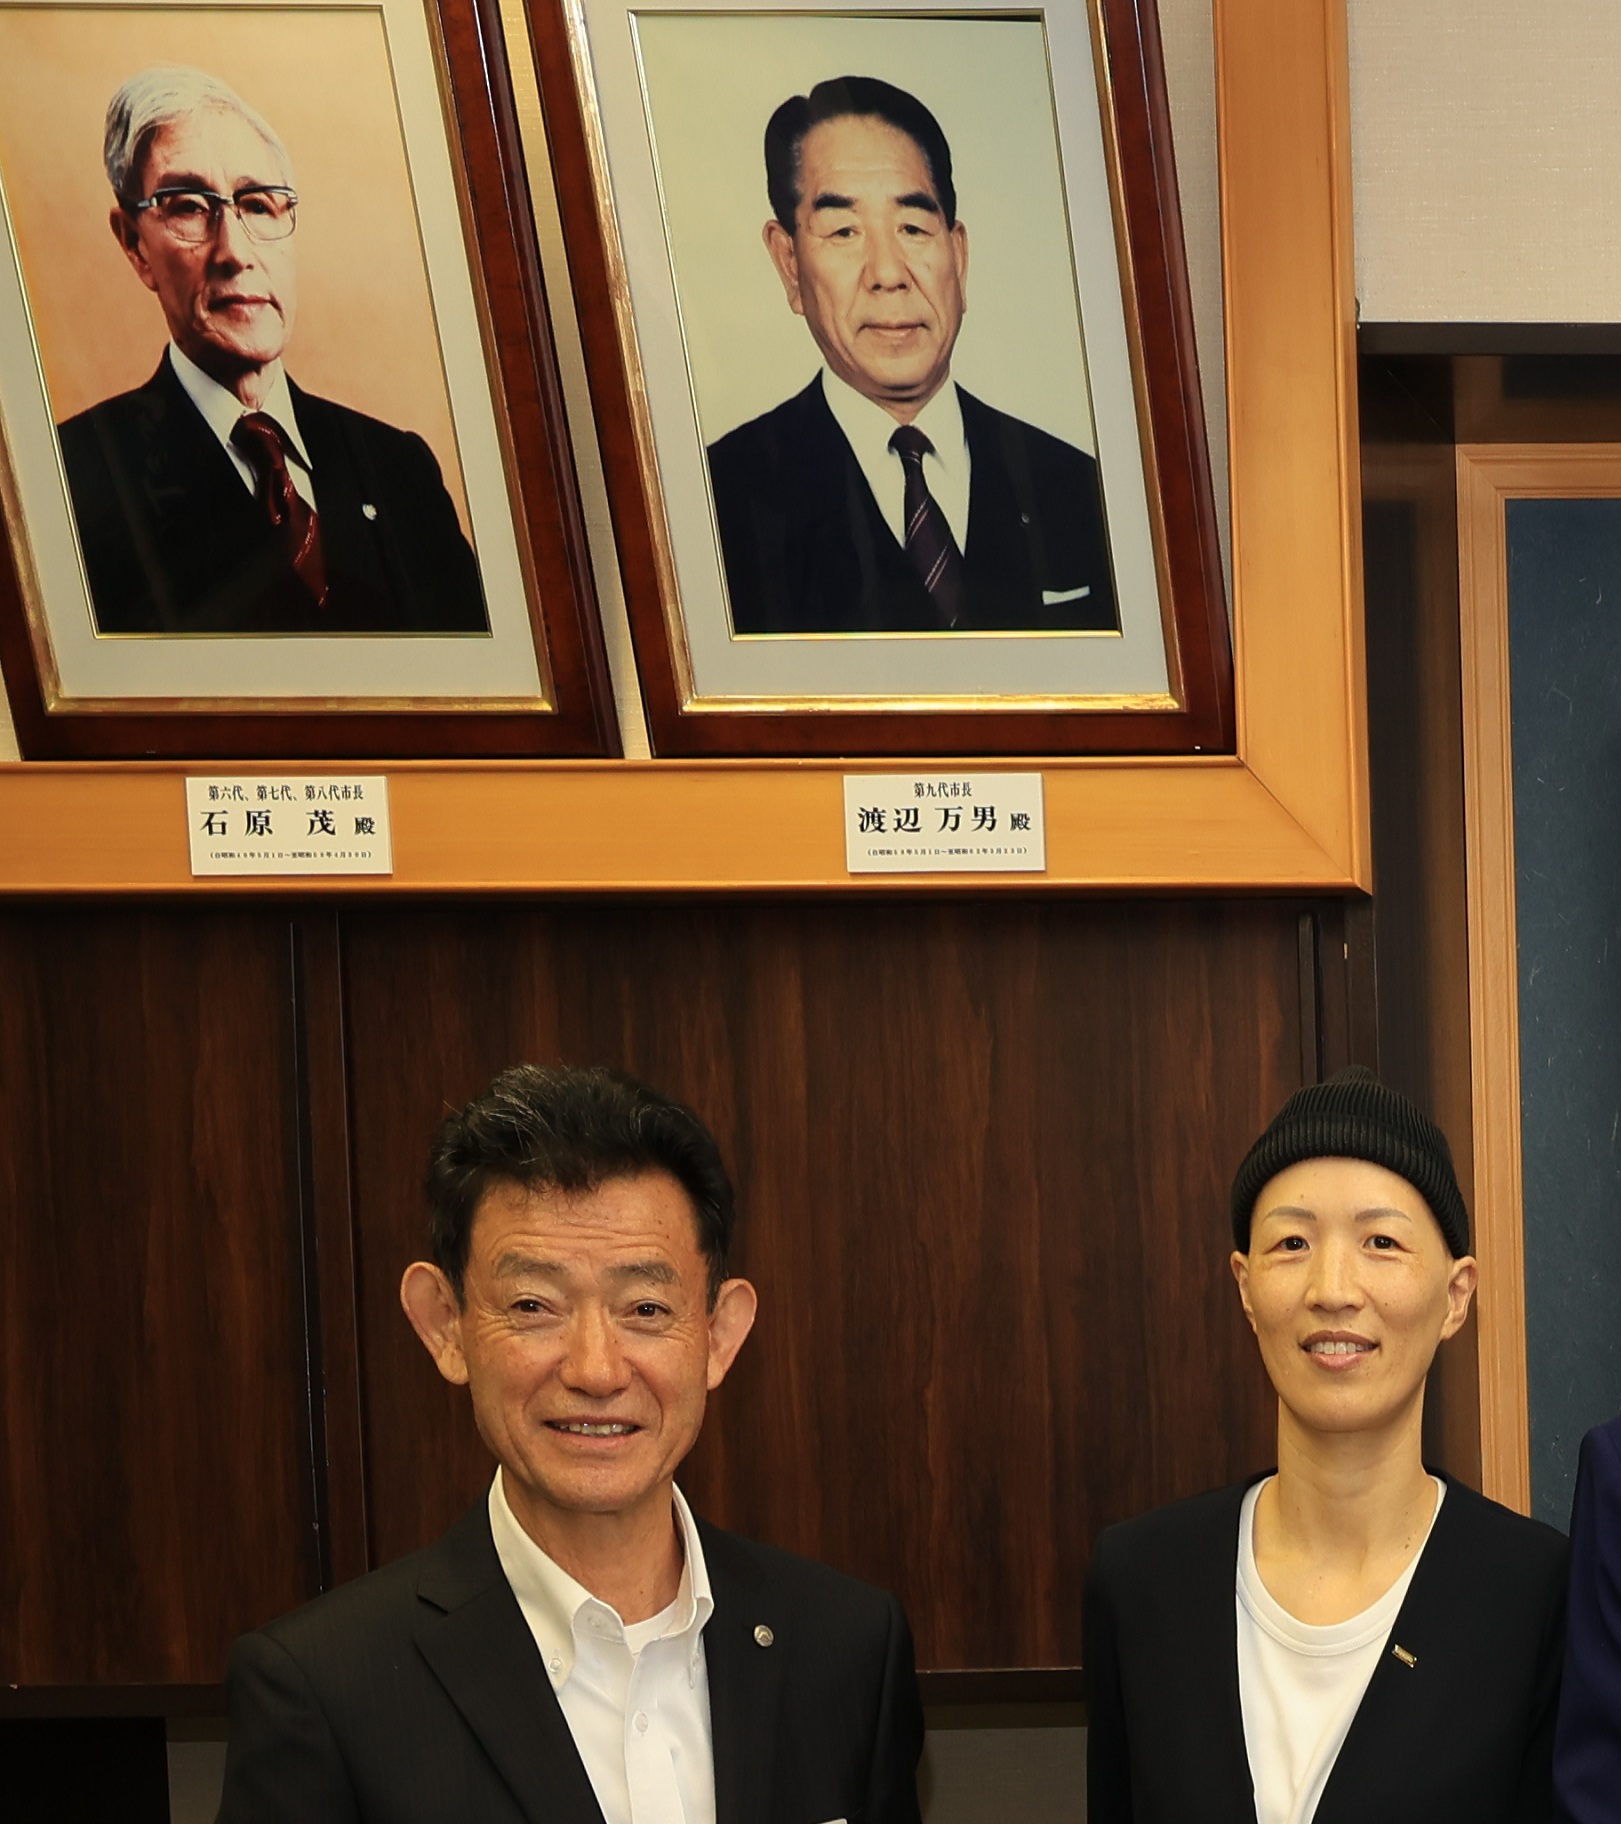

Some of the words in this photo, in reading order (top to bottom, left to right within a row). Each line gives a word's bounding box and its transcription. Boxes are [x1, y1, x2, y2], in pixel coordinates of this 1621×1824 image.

[914, 782, 972, 798] 第九代市長
[200, 809, 273, 836] 石原
[306, 809, 336, 836] 茂
[355, 817, 376, 835] 殿
[858, 806, 923, 833] 渡辺
[935, 806, 997, 832] 万男
[1010, 812, 1031, 831] 殿
